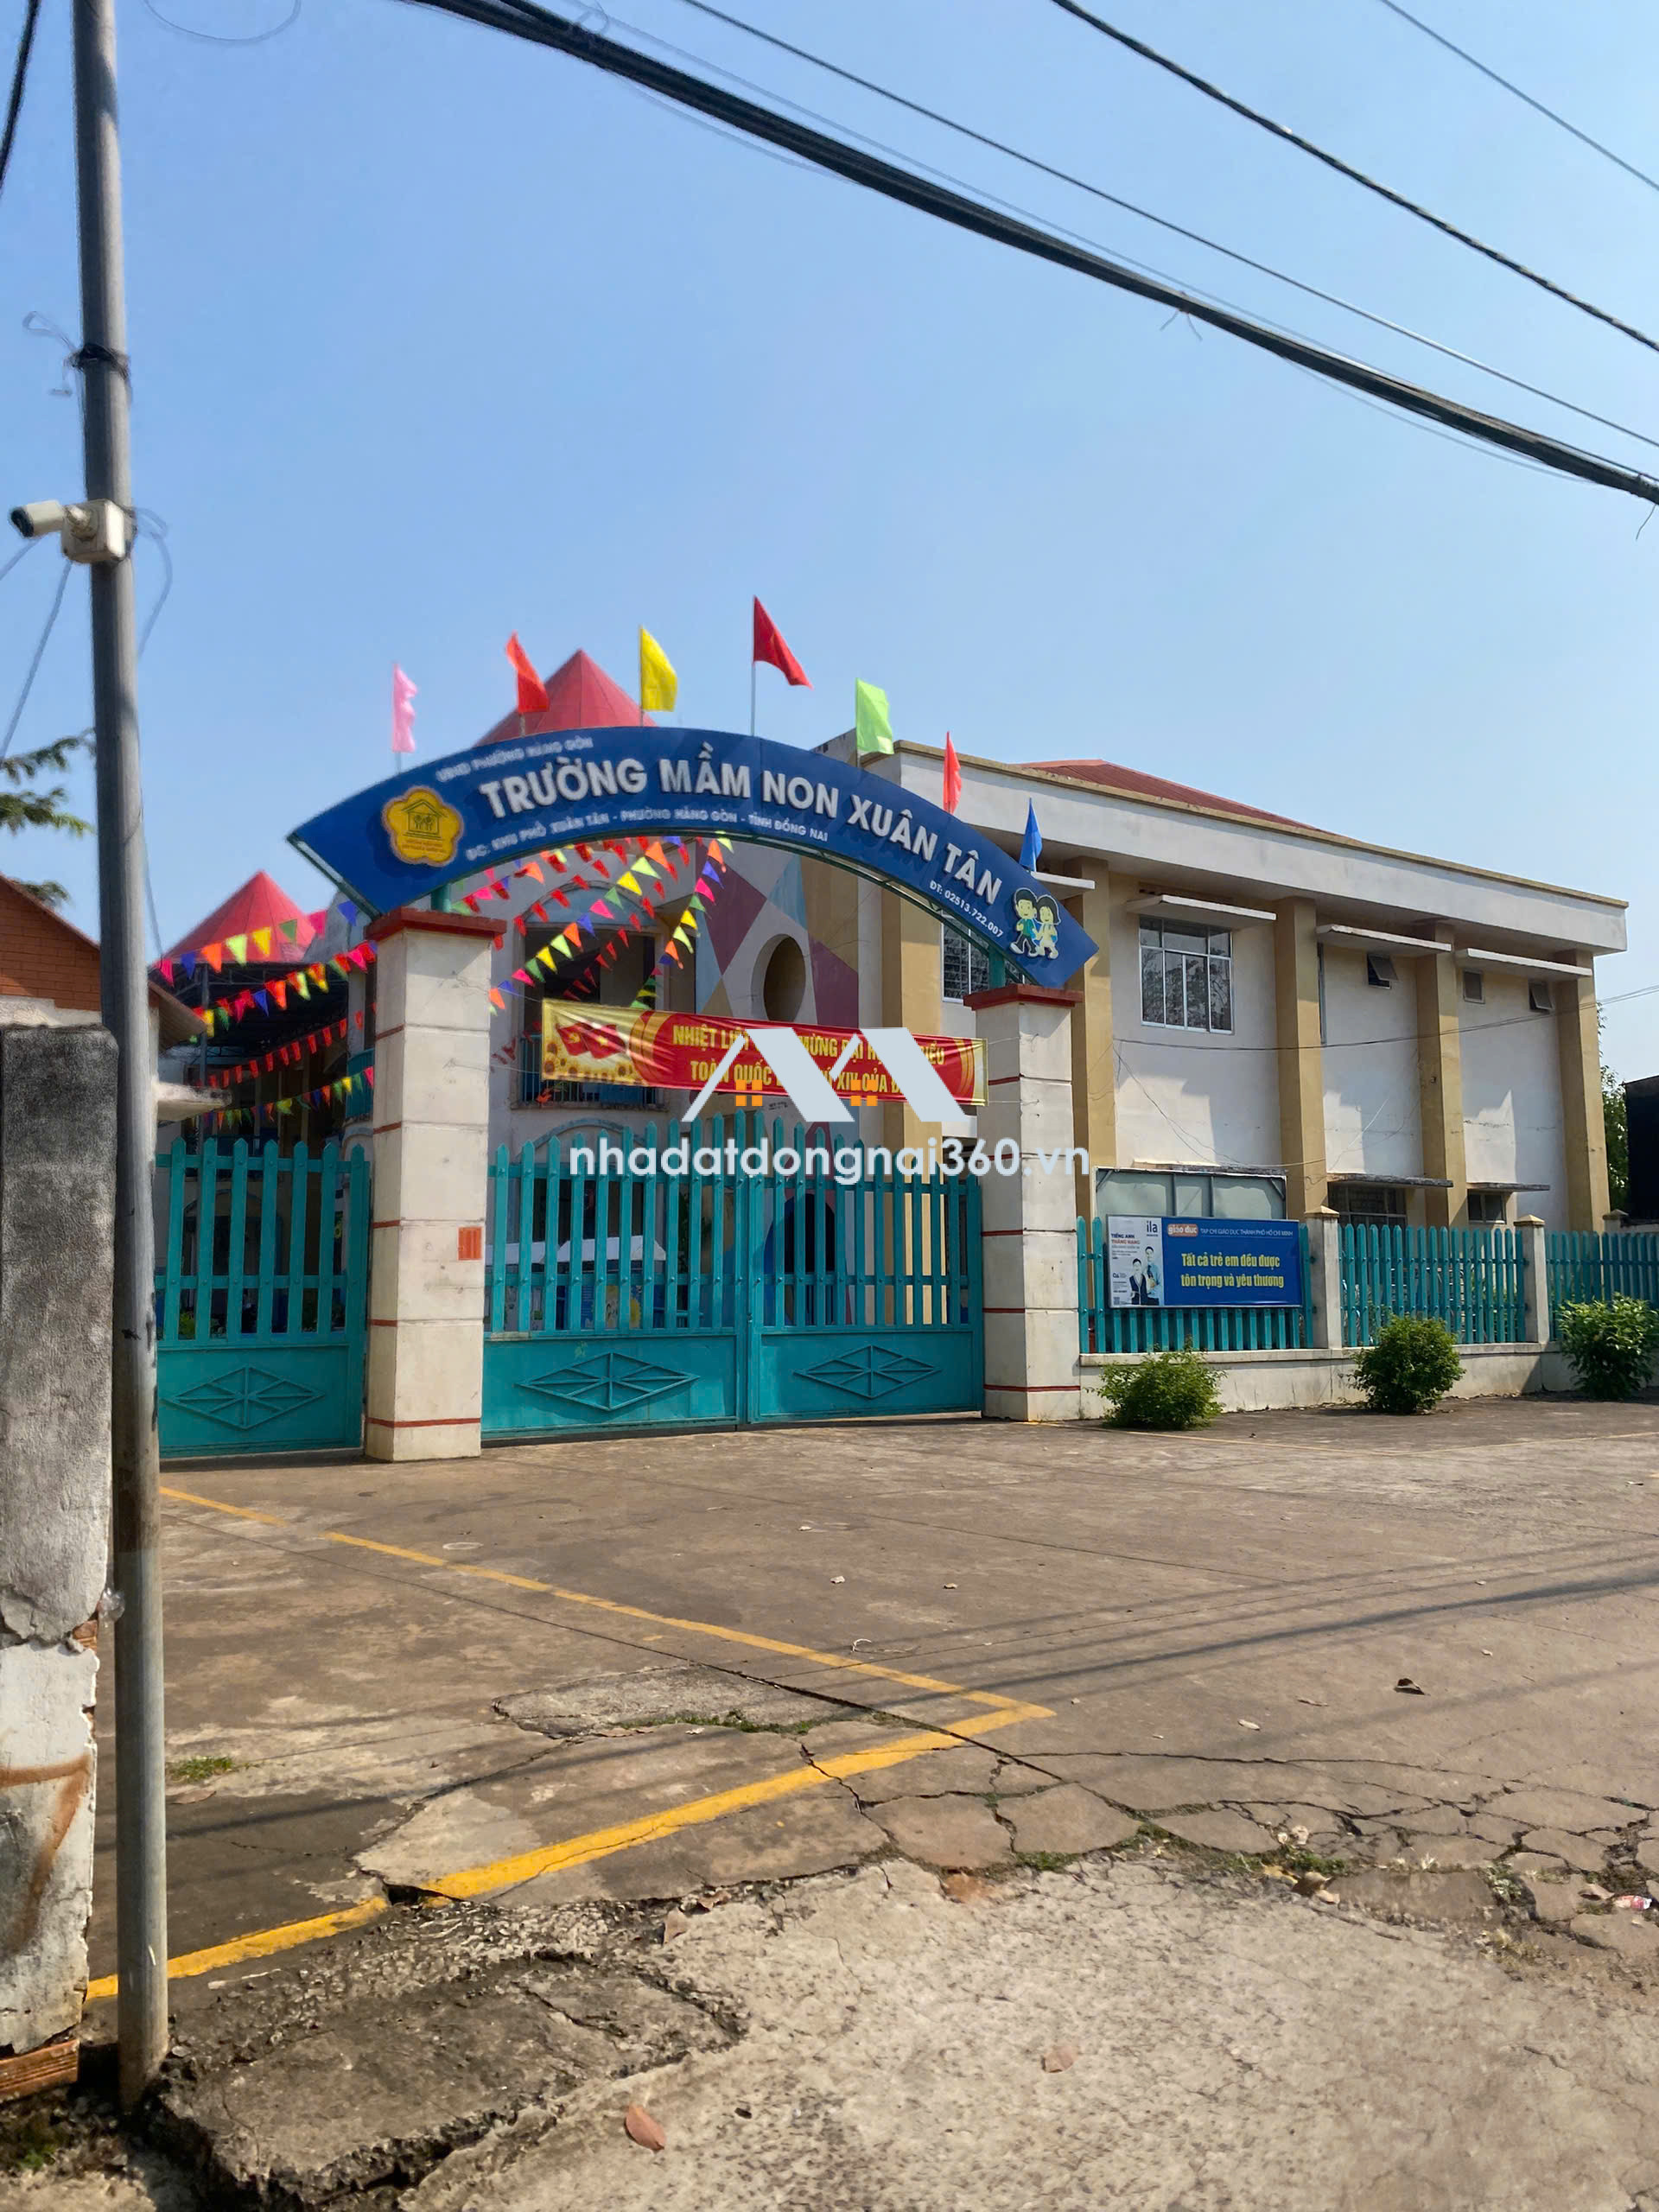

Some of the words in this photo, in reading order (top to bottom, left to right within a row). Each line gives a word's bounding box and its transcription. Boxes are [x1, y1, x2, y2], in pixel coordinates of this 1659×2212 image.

[479, 757, 647, 818] TRƯỜNG
[659, 741, 751, 798] MẦM
[763, 770, 839, 818] NON
[848, 794, 938, 861] XUÂN
[943, 842, 1002, 905] TÂN
[710, 807, 737, 823] GÒN
[774, 817, 806, 836] ĐỒNG
[809, 827, 829, 842] NAI
[944, 890, 1003, 938] 02513.722.007
[673, 1024, 717, 1052] NHIỆT
[1147, 1220, 1158, 1233] ila
[1181, 1253, 1196, 1267] Tất
[1197, 1251, 1209, 1267] cả
[1210, 1252, 1224, 1267] trẻ
[1224, 1255, 1239, 1267] em
[1258, 1254, 1281, 1270] được
[1181, 1274, 1197, 1287] tôn
[1198, 1274, 1223, 1289] trọng
[1224, 1273, 1235, 1287] và
[1236, 1274, 1252, 1287] yêu
[1254, 1274, 1284, 1288] thương
